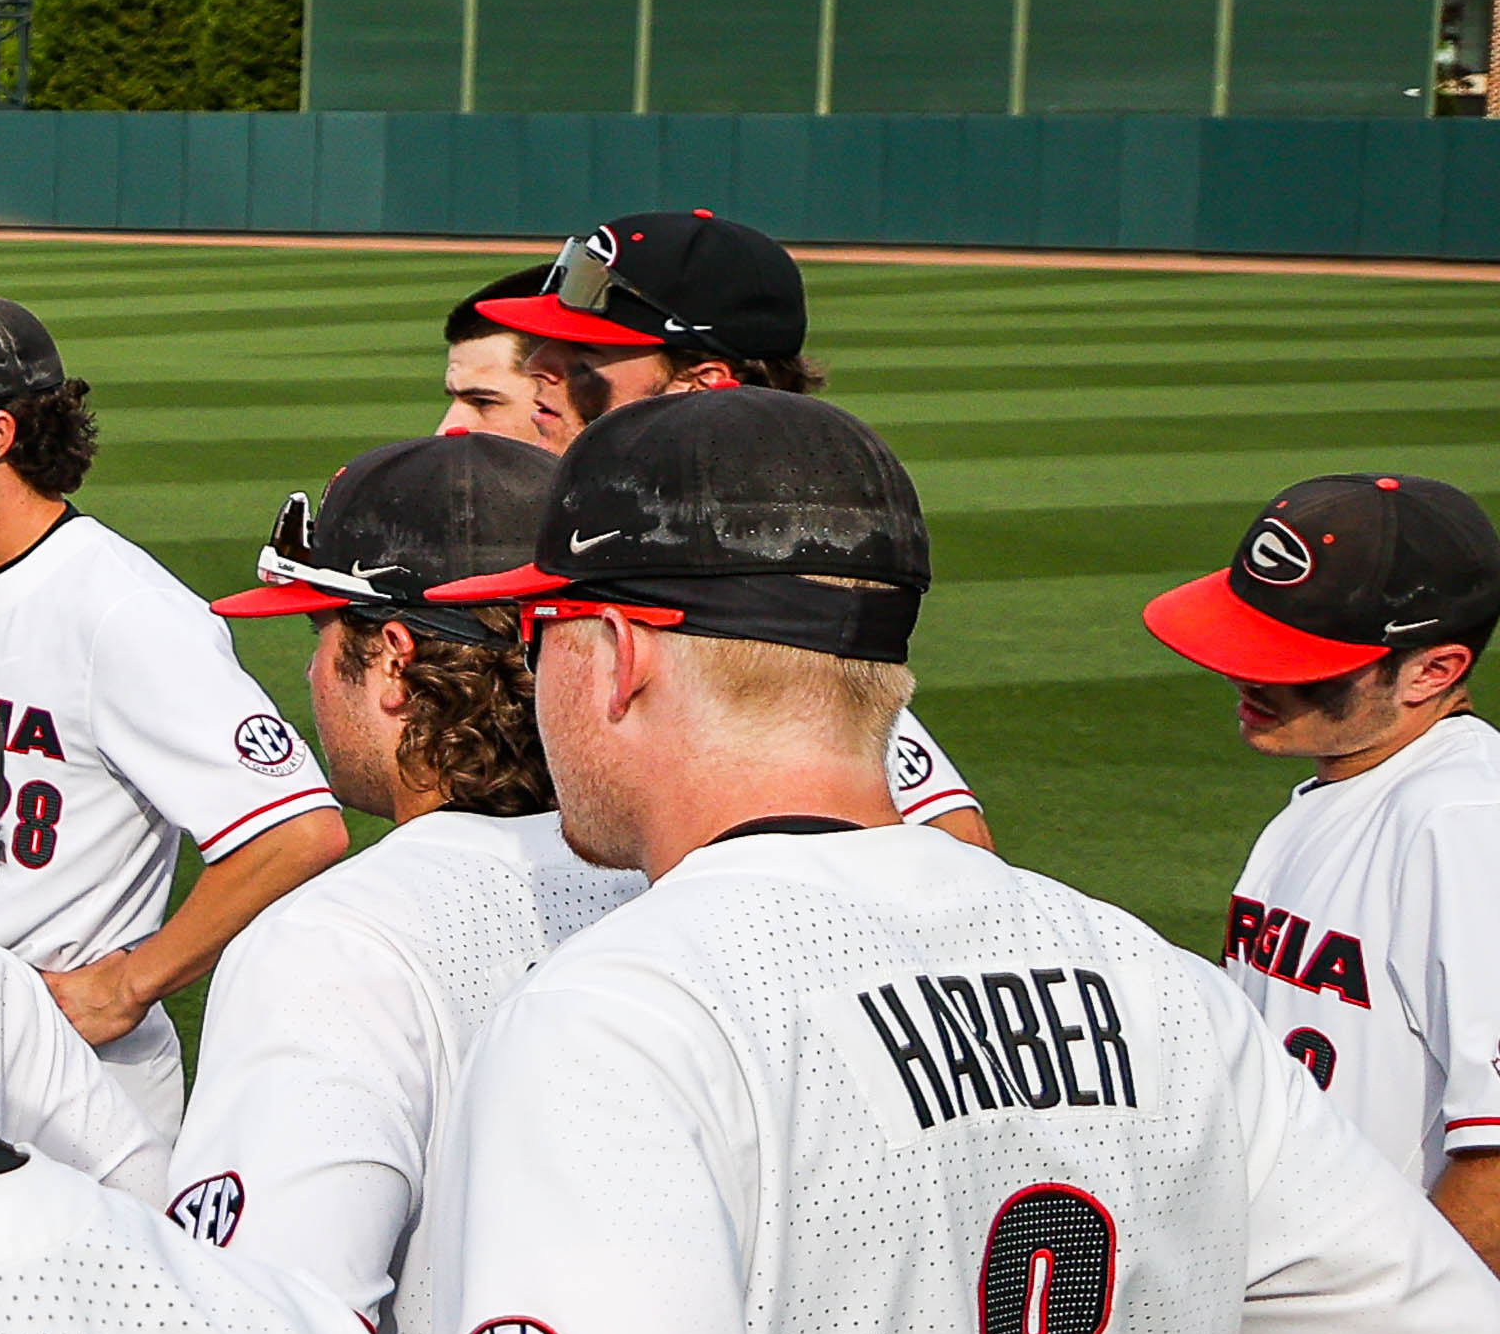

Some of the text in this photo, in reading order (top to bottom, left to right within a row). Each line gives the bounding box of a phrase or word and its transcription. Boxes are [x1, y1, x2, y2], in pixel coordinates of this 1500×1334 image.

[237, 716, 290, 764] SEC
[1223, 894, 1372, 1010] RGIA
[858, 968, 1137, 1130] HARBER
